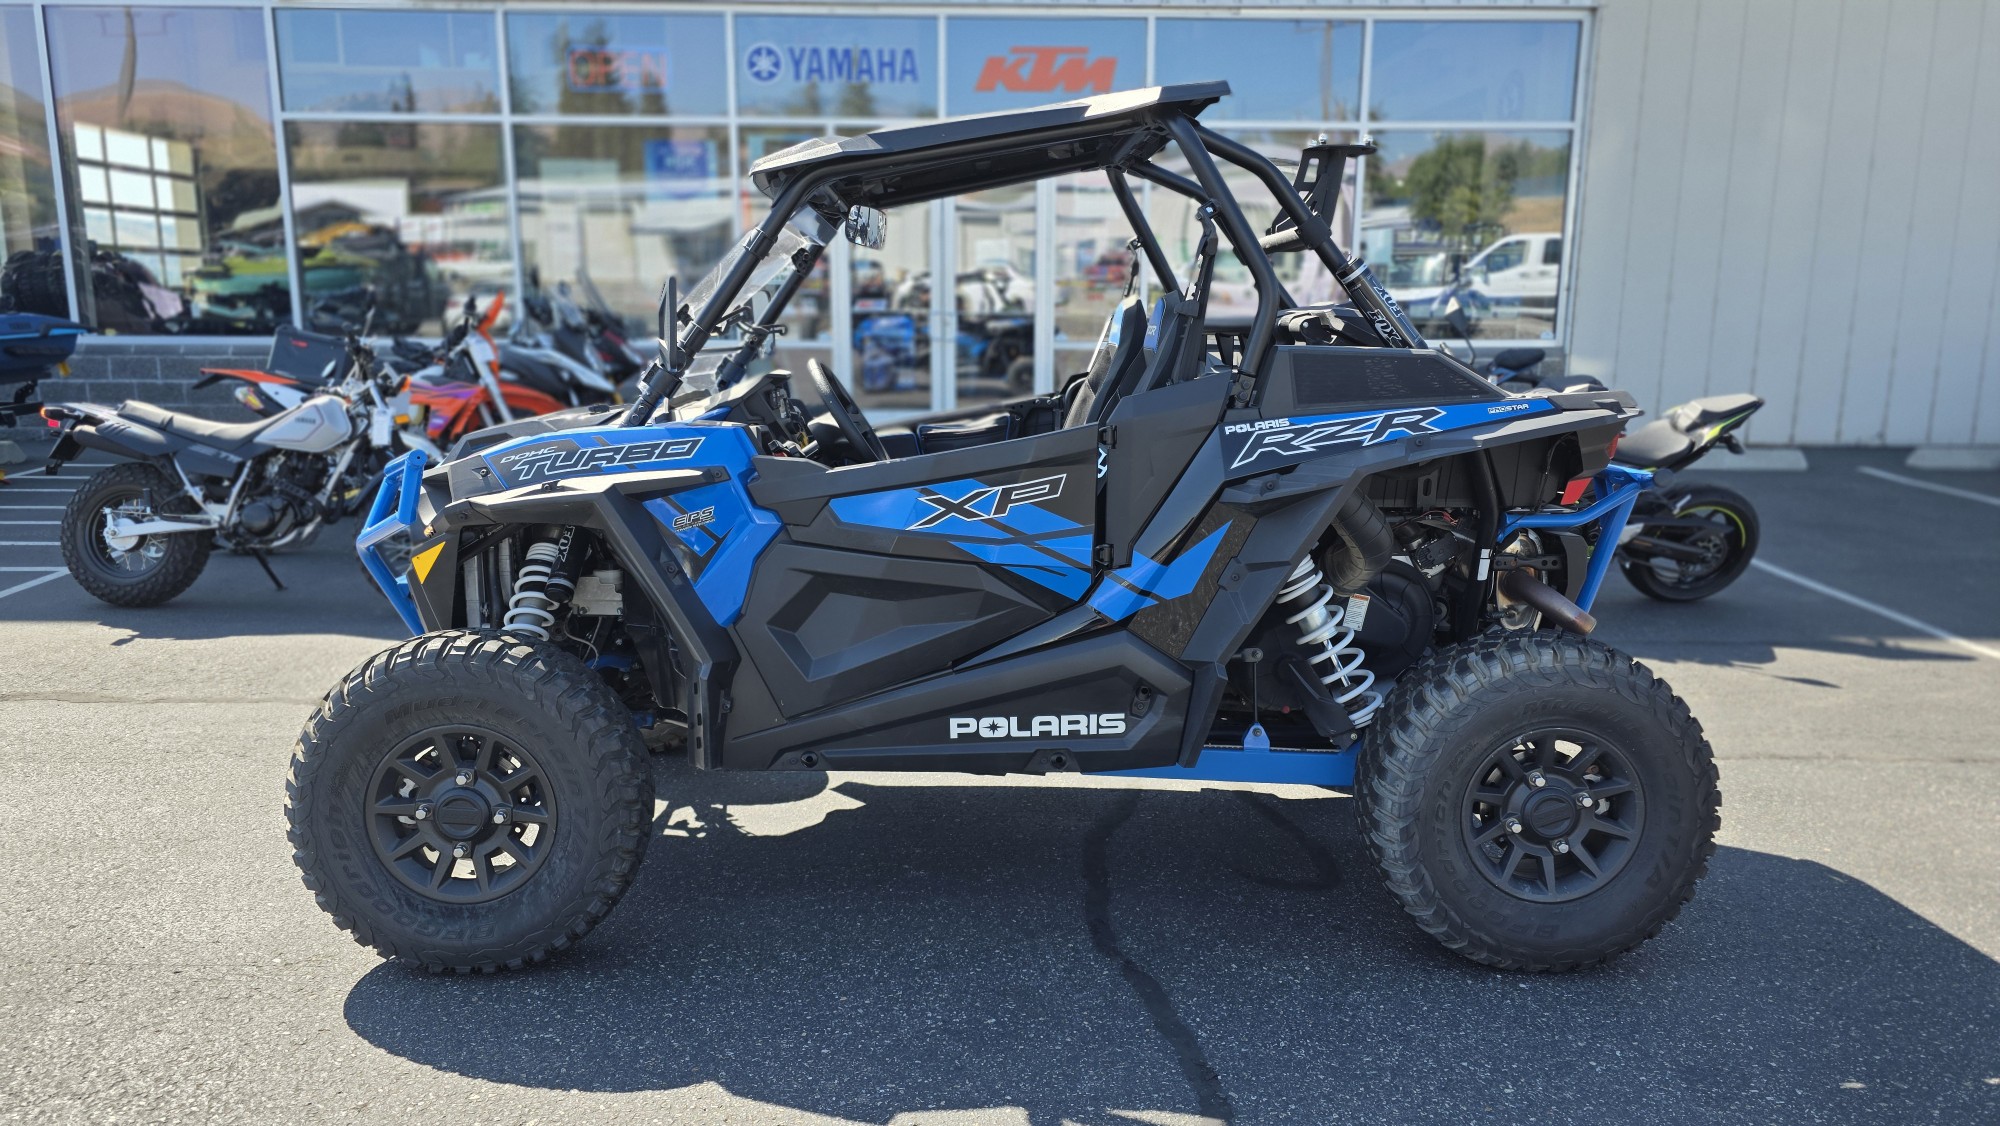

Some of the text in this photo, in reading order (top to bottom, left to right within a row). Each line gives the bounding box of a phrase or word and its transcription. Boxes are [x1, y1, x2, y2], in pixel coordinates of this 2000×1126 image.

[570, 49, 667, 88] OPEN
[788, 47, 919, 84] YAMAHA
[974, 46, 1118, 92] KTM
[1367, 308, 1402, 341] FOX
[1225, 418, 1290, 434] POLARIS
[1231, 407, 1446, 469] RZR
[500, 446, 557, 464] DOHC
[511, 437, 706, 480] TURBO
[672, 506, 714, 527] EPS
[905, 474, 1066, 530] XP
[557, 524, 576, 563] FOX
[949, 713, 1126, 739] POLARIS
